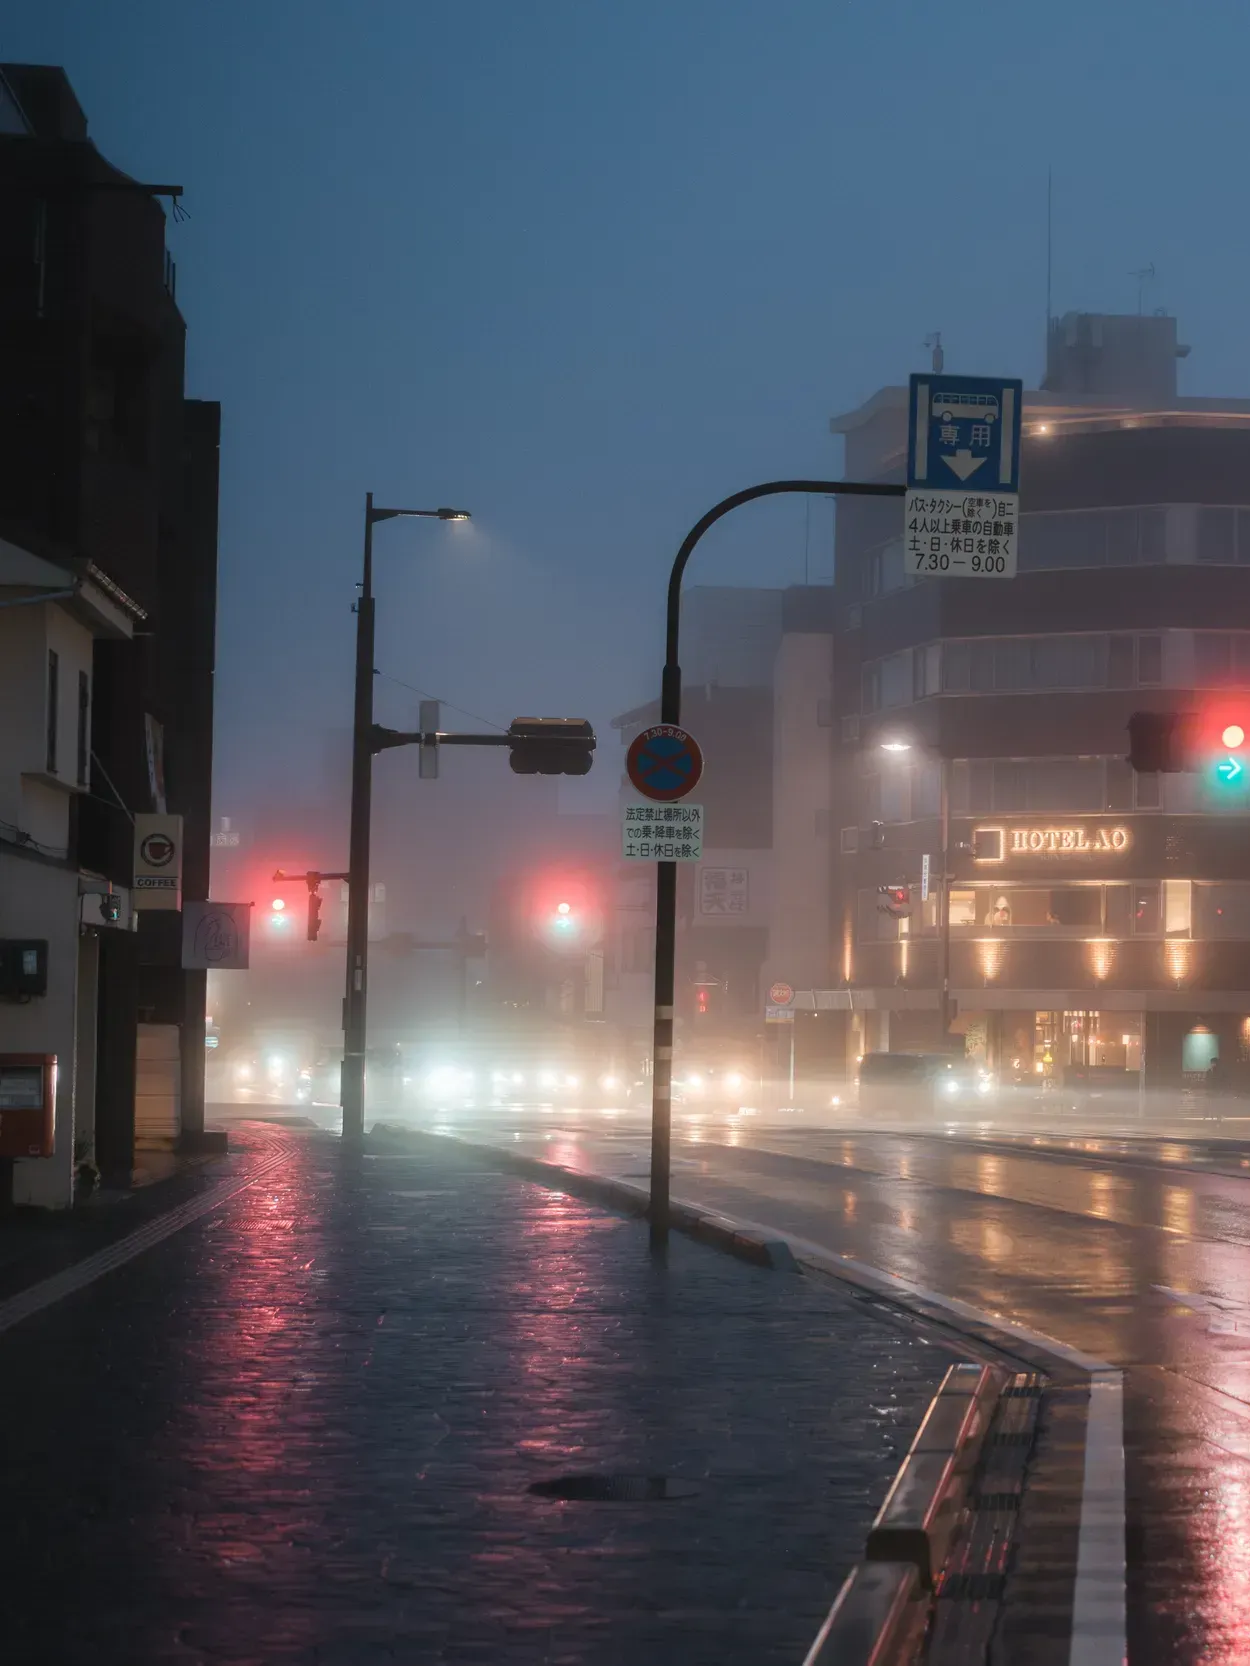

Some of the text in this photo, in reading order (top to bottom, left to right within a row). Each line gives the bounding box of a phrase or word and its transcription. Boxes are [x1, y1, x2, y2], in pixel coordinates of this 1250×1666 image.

[939, 425, 991, 447] 専用
[908, 518, 1014, 536] 4人以上乗車の自動車
[908, 536, 1010, 554] 土・日・休日を除く
[626, 808, 700, 822] 法定禁止場所以外
[1010, 829, 1089, 850] HOTEL
[626, 843, 699, 857] 土・日・休日を除く
[137, 878, 176, 887] COFFEE
